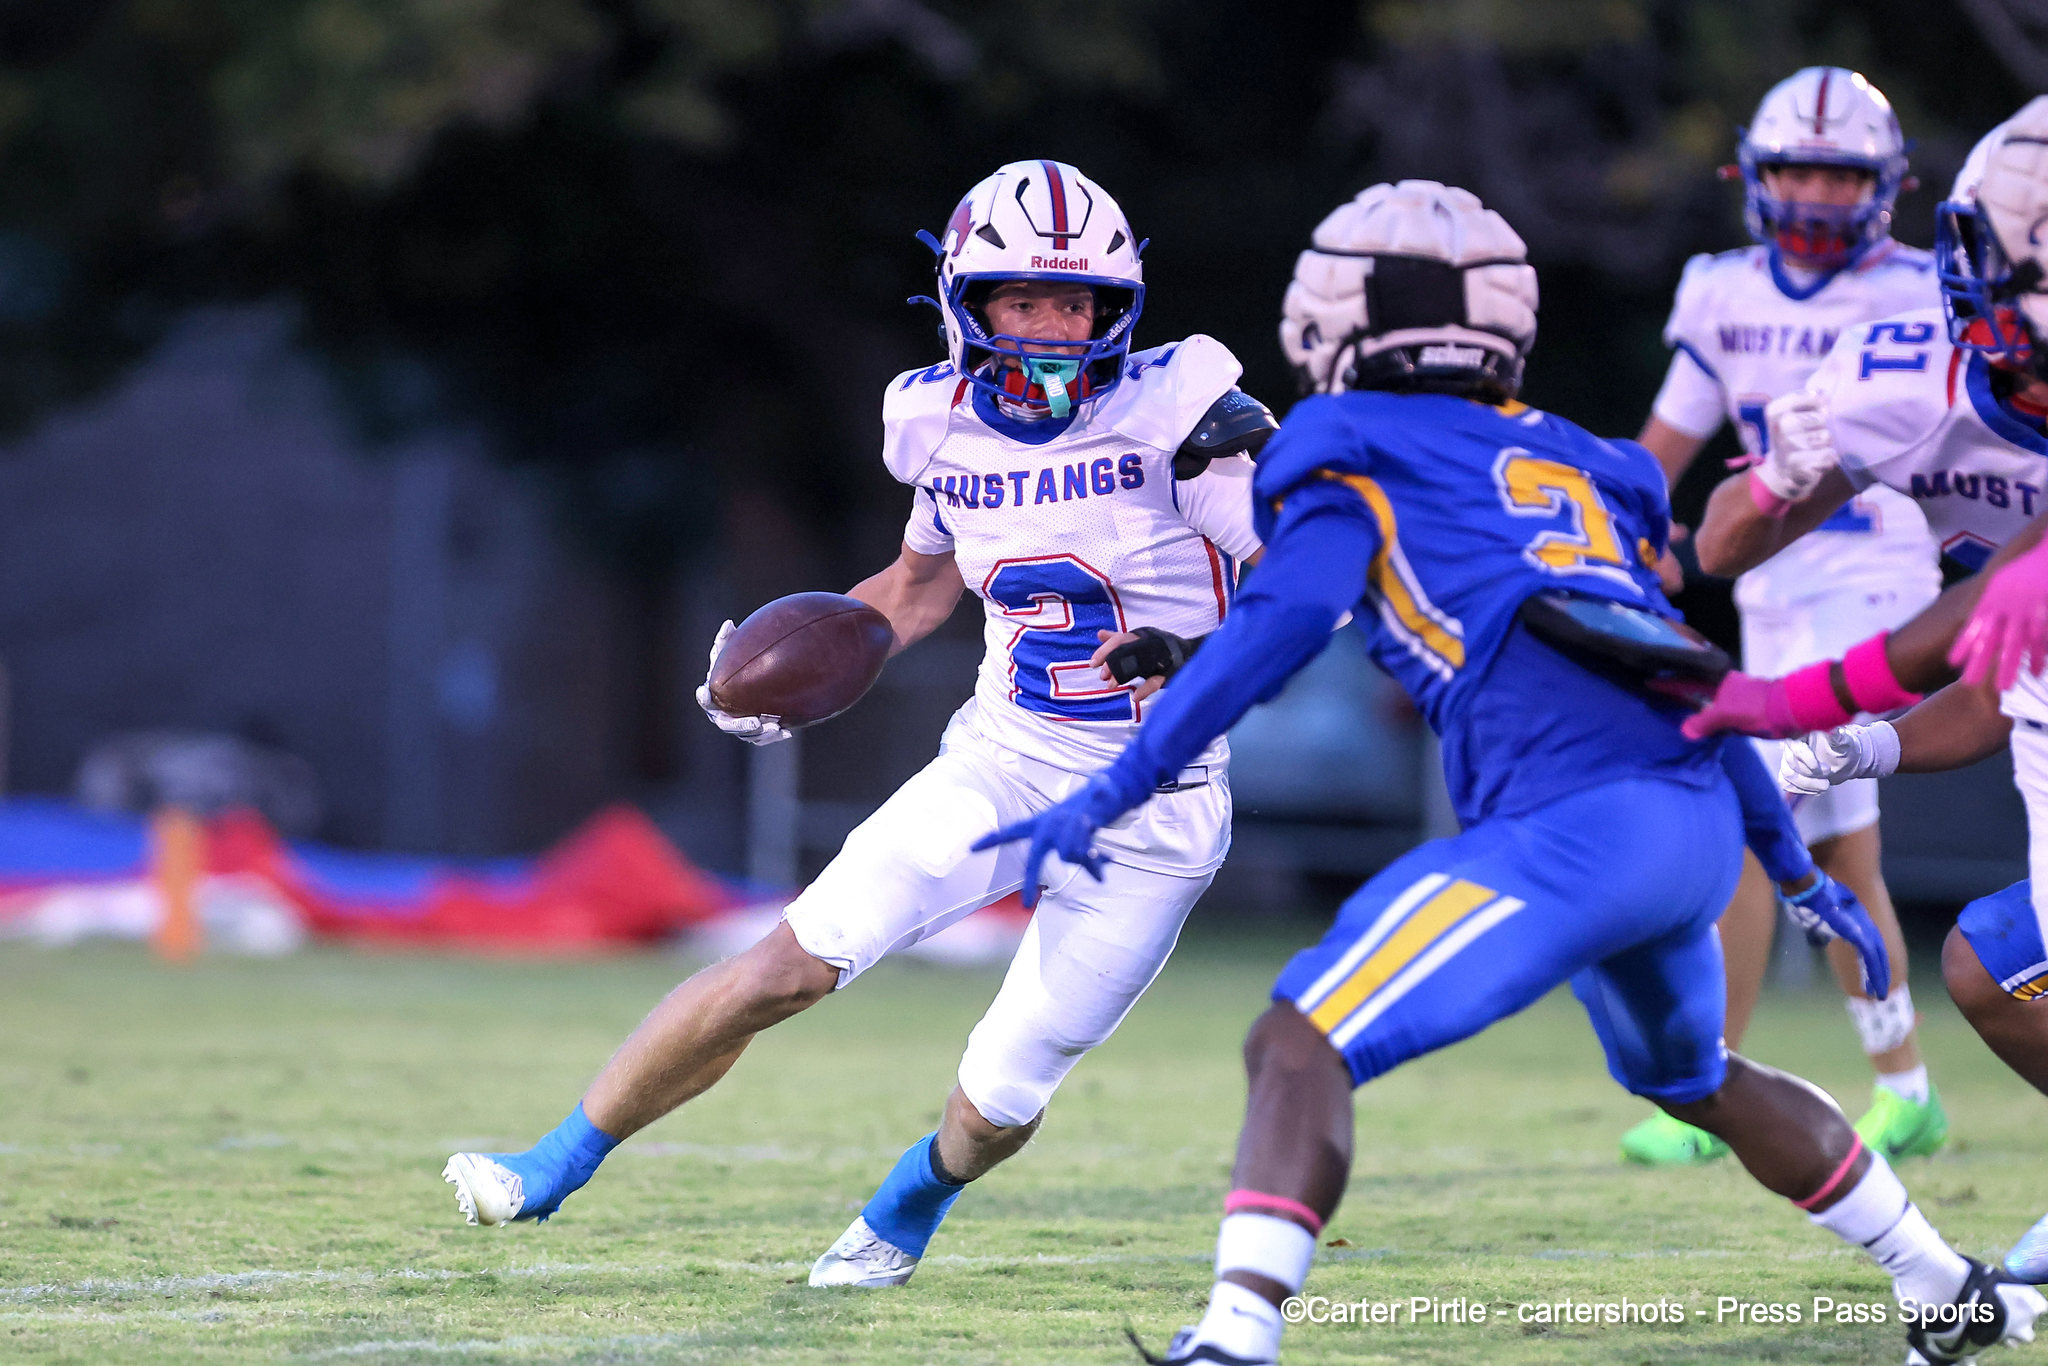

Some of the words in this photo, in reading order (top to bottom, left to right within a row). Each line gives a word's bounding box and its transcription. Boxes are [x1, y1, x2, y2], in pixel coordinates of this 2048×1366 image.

[1031, 255, 1089, 271] Riddell
[932, 452, 1146, 510] MUSTANGS
[982, 552, 1142, 724] 2
